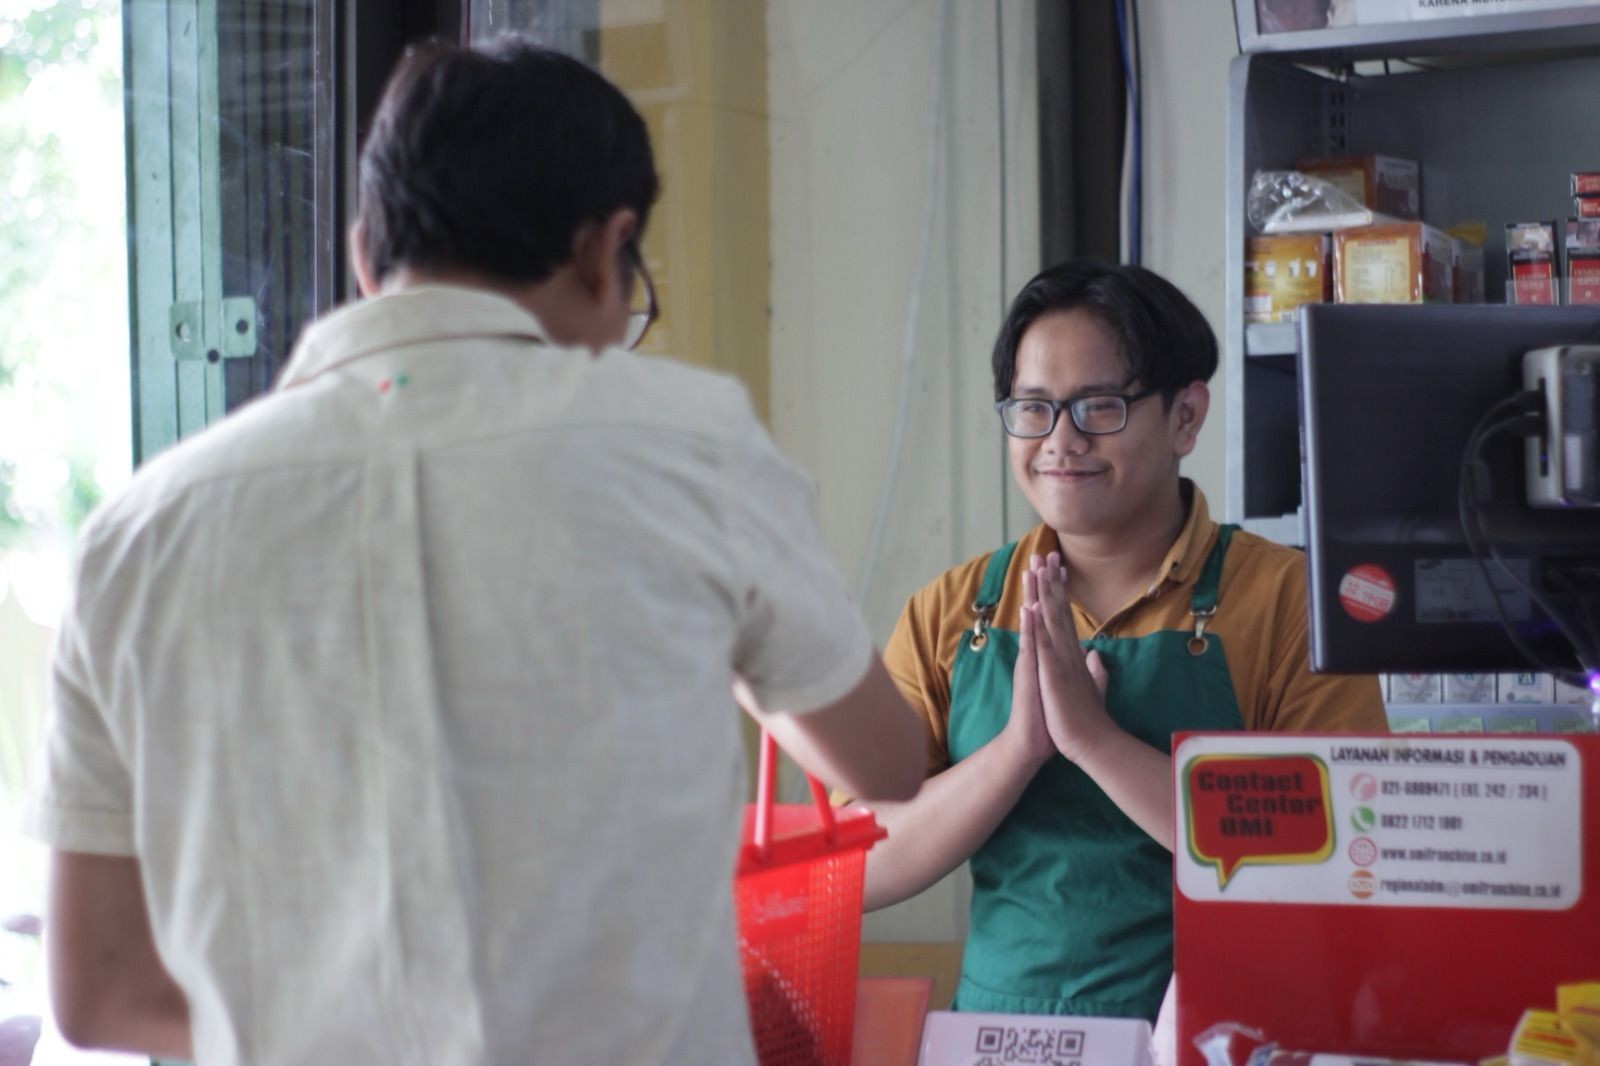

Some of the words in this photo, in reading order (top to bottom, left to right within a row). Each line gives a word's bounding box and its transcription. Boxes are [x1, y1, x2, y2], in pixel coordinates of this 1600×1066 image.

[1331, 746, 1389, 762] LAYANAN
[1393, 747, 1464, 765] INFORMASI
[1483, 750, 1566, 768] PENGADUAN
[1198, 770, 1303, 792] Contact
[1227, 794, 1321, 815] Center
